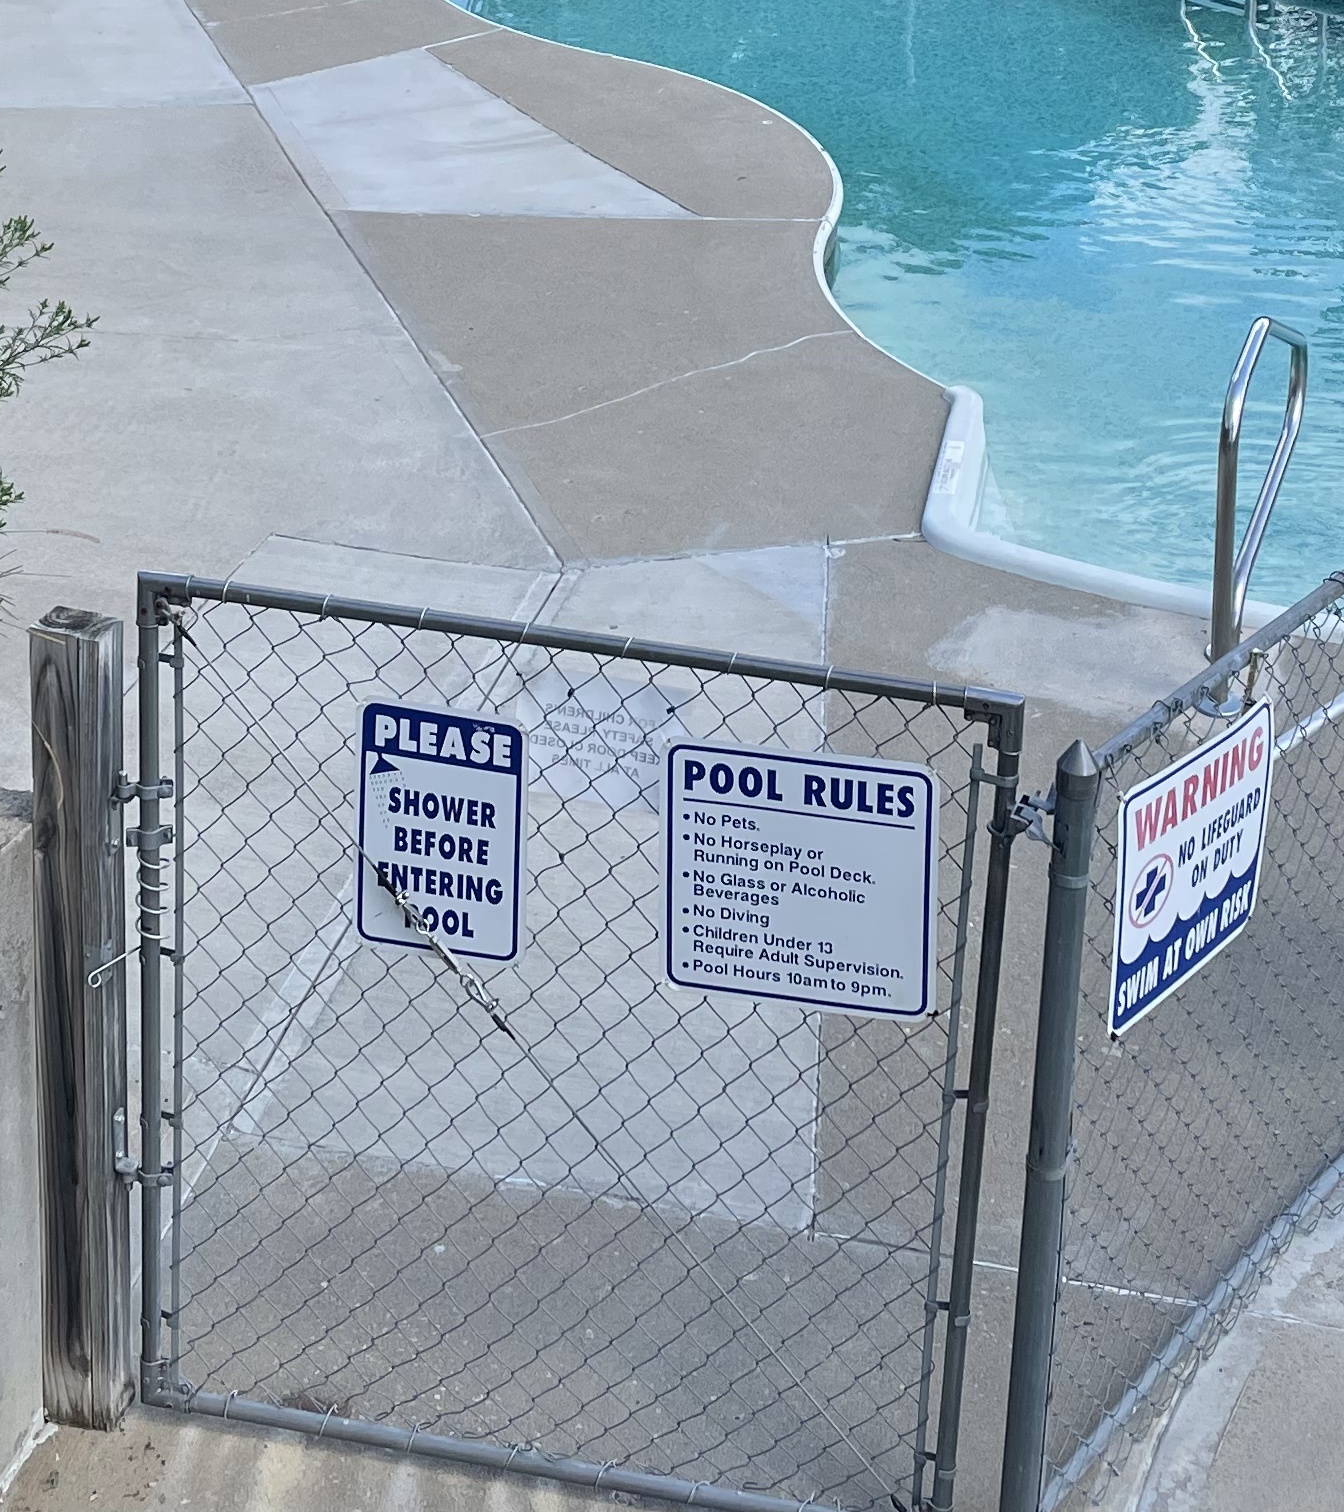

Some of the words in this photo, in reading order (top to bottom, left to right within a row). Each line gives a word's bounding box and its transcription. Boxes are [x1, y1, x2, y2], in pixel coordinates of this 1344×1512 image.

[374, 713, 512, 768] PLEASE
[388, 787, 496, 829] SHOWER
[683, 759, 783, 801] POOL
[803, 773, 915, 818] RULES
[1135, 726, 1264, 851] WARNING
[693, 811, 716, 826] No
[721, 815, 760, 832] Pets.
[1178, 836, 1196, 867] NO
[1201, 787, 1261, 851] LIFEGUARD
[394, 825, 489, 866] BEFORE
[693, 832, 716, 847] No
[721, 836, 802, 861] Horseplay
[807, 847, 824, 860] or
[1191, 856, 1209, 888] ON
[1213, 828, 1244, 872] DUTY
[377, 861, 504, 905] ENTERING
[693, 849, 759, 871] Running
[763, 858, 785, 872] on
[789, 860, 825, 878] Pool
[830, 866, 876, 885] Deck.
[693, 870, 716, 884] No
[720, 873, 766, 890] Glass
[770, 880, 787, 893] or
[791, 882, 866, 904] Alcoholic
[693, 884, 780, 906] Beverages
[693, 904, 716, 918] No
[720, 906, 770, 928] Diving
[693, 924, 759, 944] Children
[763, 932, 812, 952] Under
[817, 941, 833, 954] 13
[1117, 956, 1159, 1016] SWIM
[1163, 937, 1182, 980] AT
[1185, 907, 1218, 960] OWN
[1220, 880, 1252, 932] RISK
[693, 940, 754, 959] Require
[759, 948, 800, 966] Adult
[804, 954, 904, 979] Supervision.
[693, 959, 729, 975] Pool
[733, 964, 781, 982] Hours
[787, 972, 828, 989] 10am
[830, 977, 846, 991] to
[851, 980, 892, 998] 9pm.
